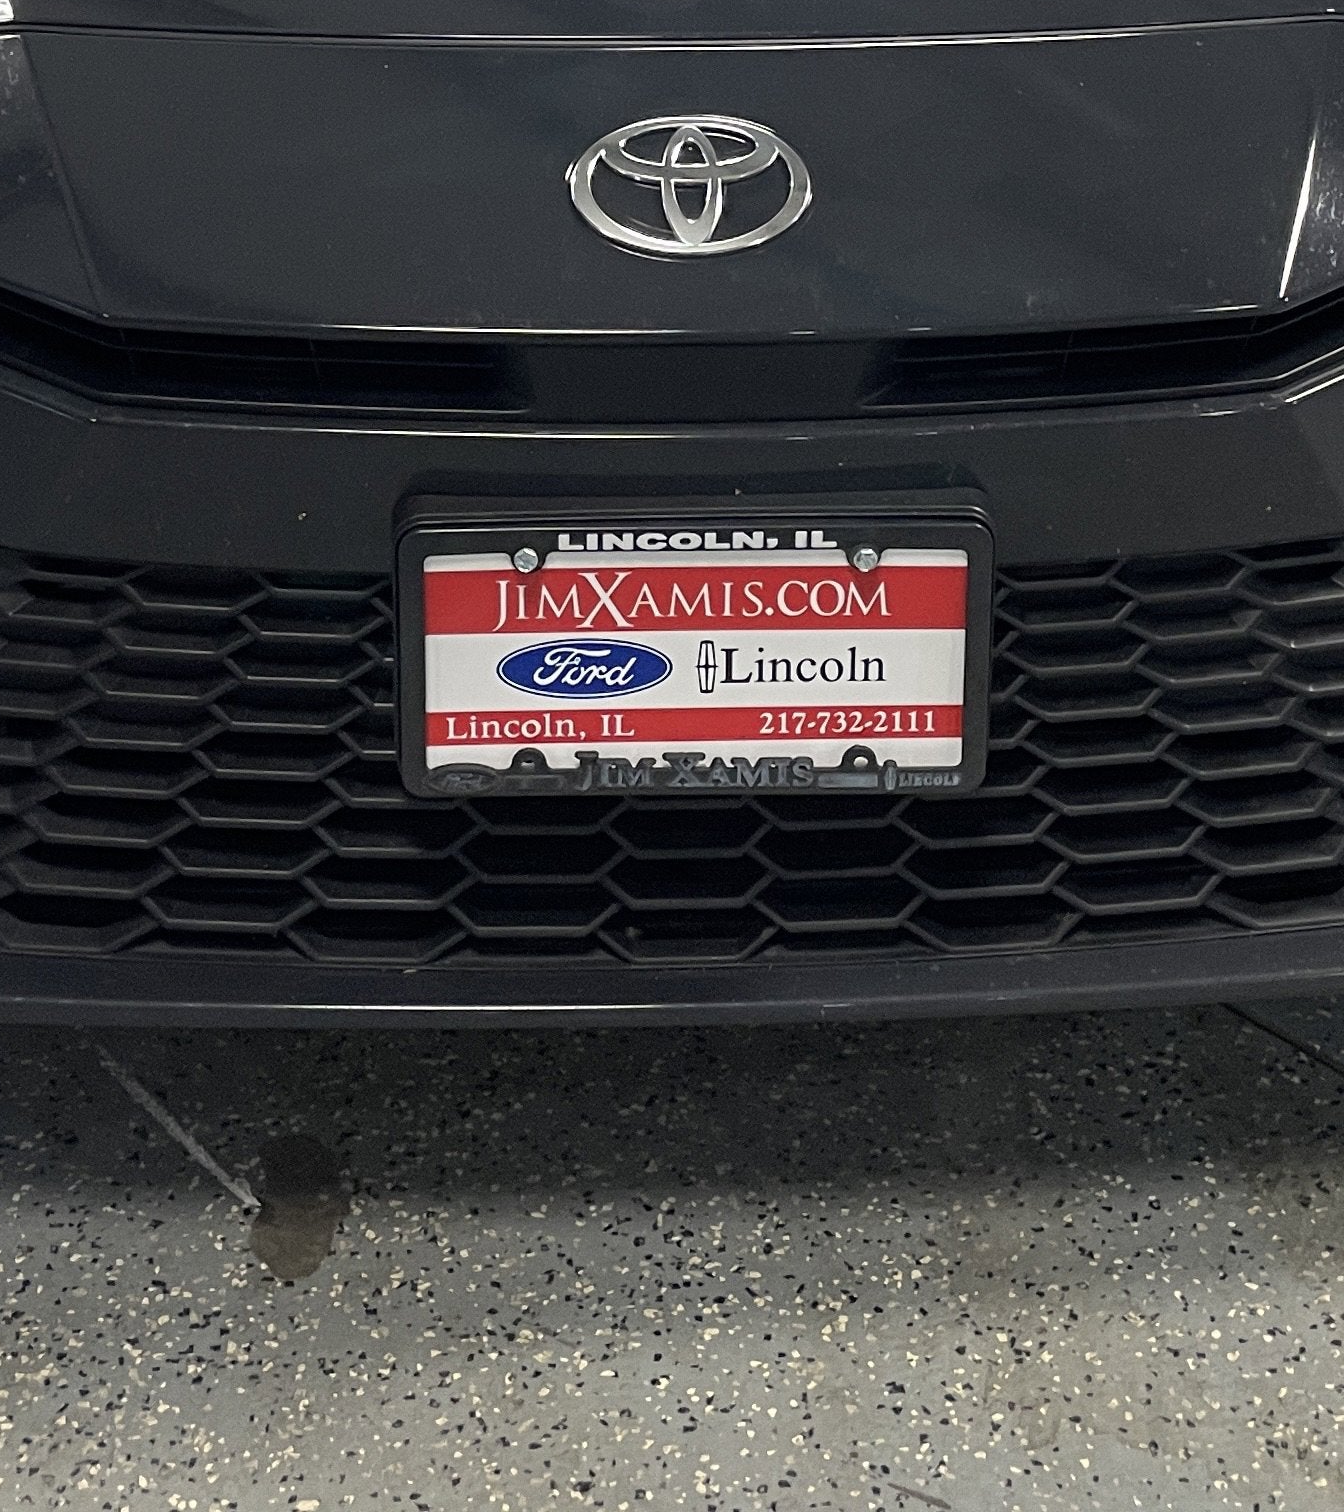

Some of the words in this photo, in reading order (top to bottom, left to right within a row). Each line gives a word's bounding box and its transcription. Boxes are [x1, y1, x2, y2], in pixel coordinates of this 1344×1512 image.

[557, 530, 779, 552] LINCOLN,
[794, 530, 838, 549] IL
[492, 571, 891, 632] JIMXAMIS.COM
[533, 647, 636, 687] Ford
[719, 647, 887, 684] Lincoln
[446, 714, 587, 742] Lincoln,
[600, 714, 635, 737] IL
[759, 710, 935, 735] 217-732-2111
[575, 751, 656, 791] JIM
[662, 752, 814, 789] XAMIS
